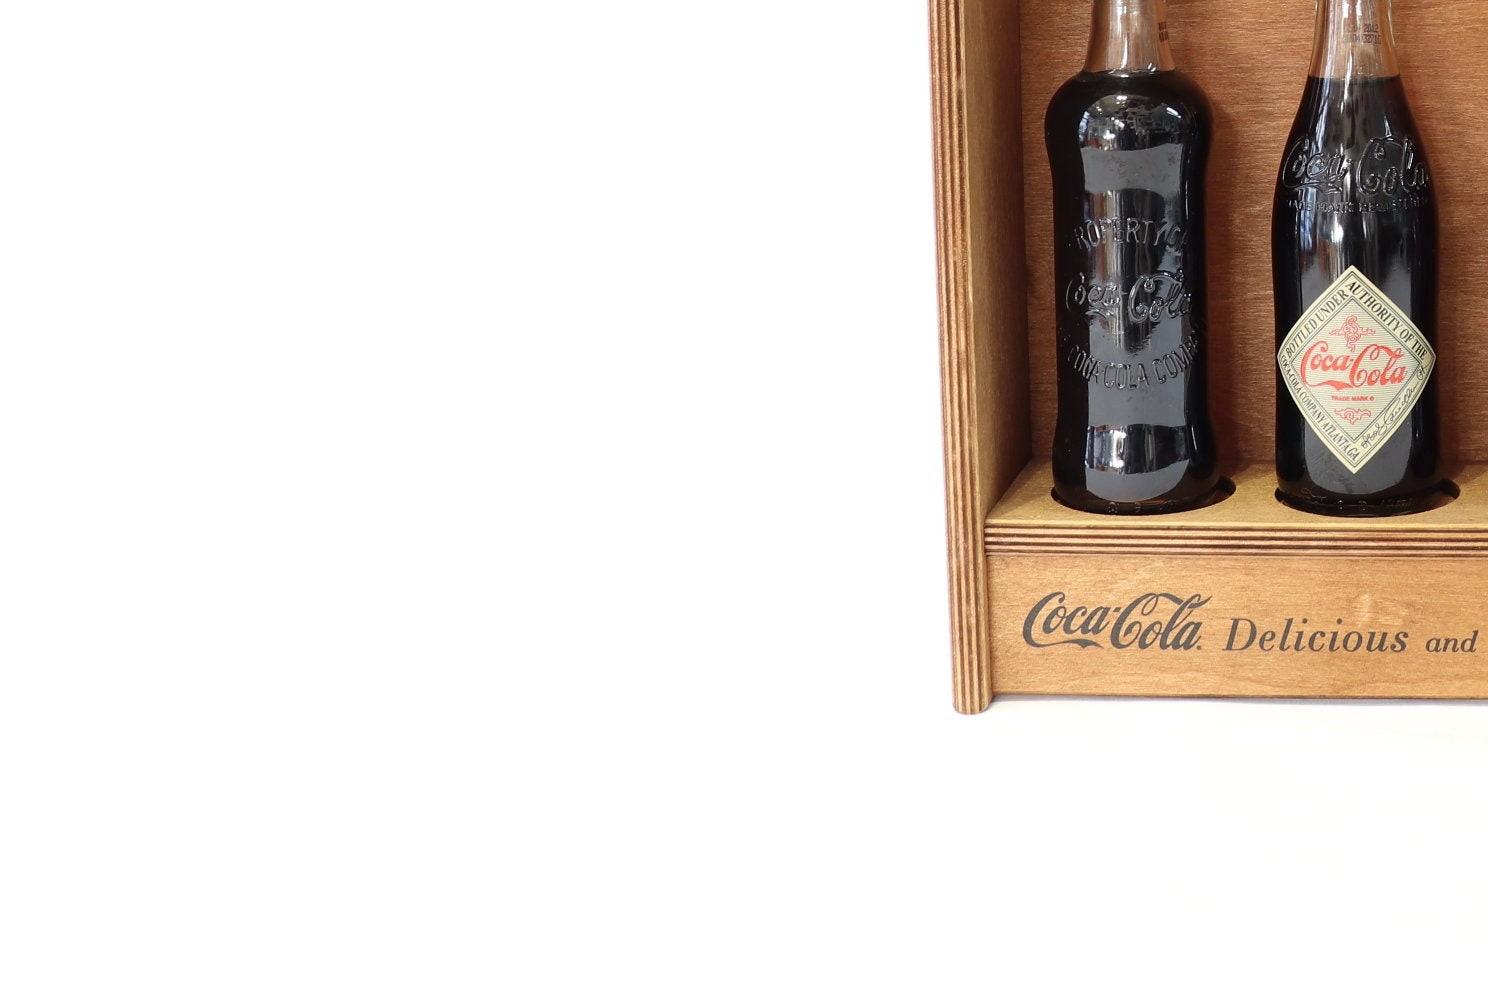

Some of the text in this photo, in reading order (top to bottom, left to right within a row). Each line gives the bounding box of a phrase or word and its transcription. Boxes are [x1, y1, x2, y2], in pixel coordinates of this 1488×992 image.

[1285, 281, 1428, 361] BOTTLED UNDER AUTHORITY OF THE
[1300, 340, 1408, 391] Coca-Cola
[1299, 390, 1327, 424] COMPANY
[1022, 591, 1213, 651] Coca-Cola
[1224, 617, 1408, 652] Delicious
[1425, 630, 1479, 653] and
